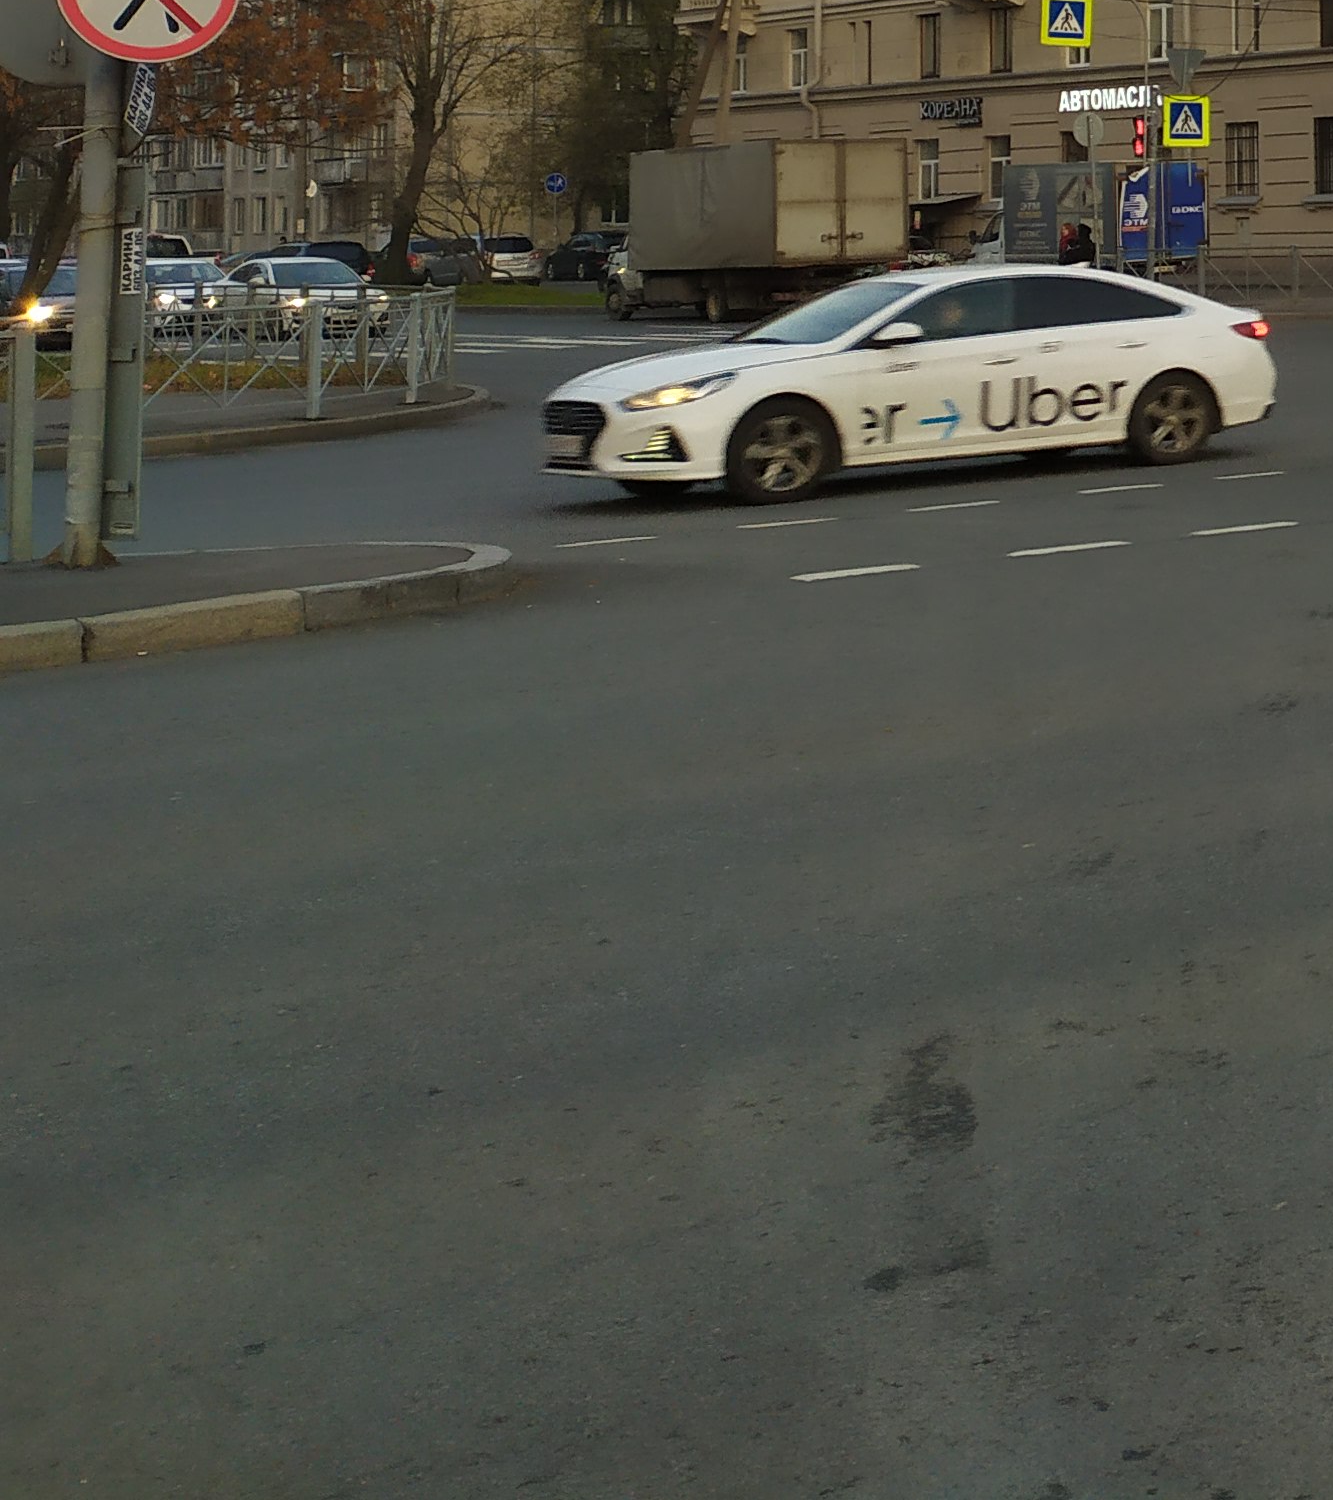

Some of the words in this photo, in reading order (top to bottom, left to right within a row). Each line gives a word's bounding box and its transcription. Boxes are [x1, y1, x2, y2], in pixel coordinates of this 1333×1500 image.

[126, 67, 148, 125] КАРИНА
[919, 98, 979, 119] КОРЕАНА
[1020, 202, 1041, 211] ЭТМ
[122, 231, 133, 292] КАРИНА
[980, 376, 1128, 432] Uber
